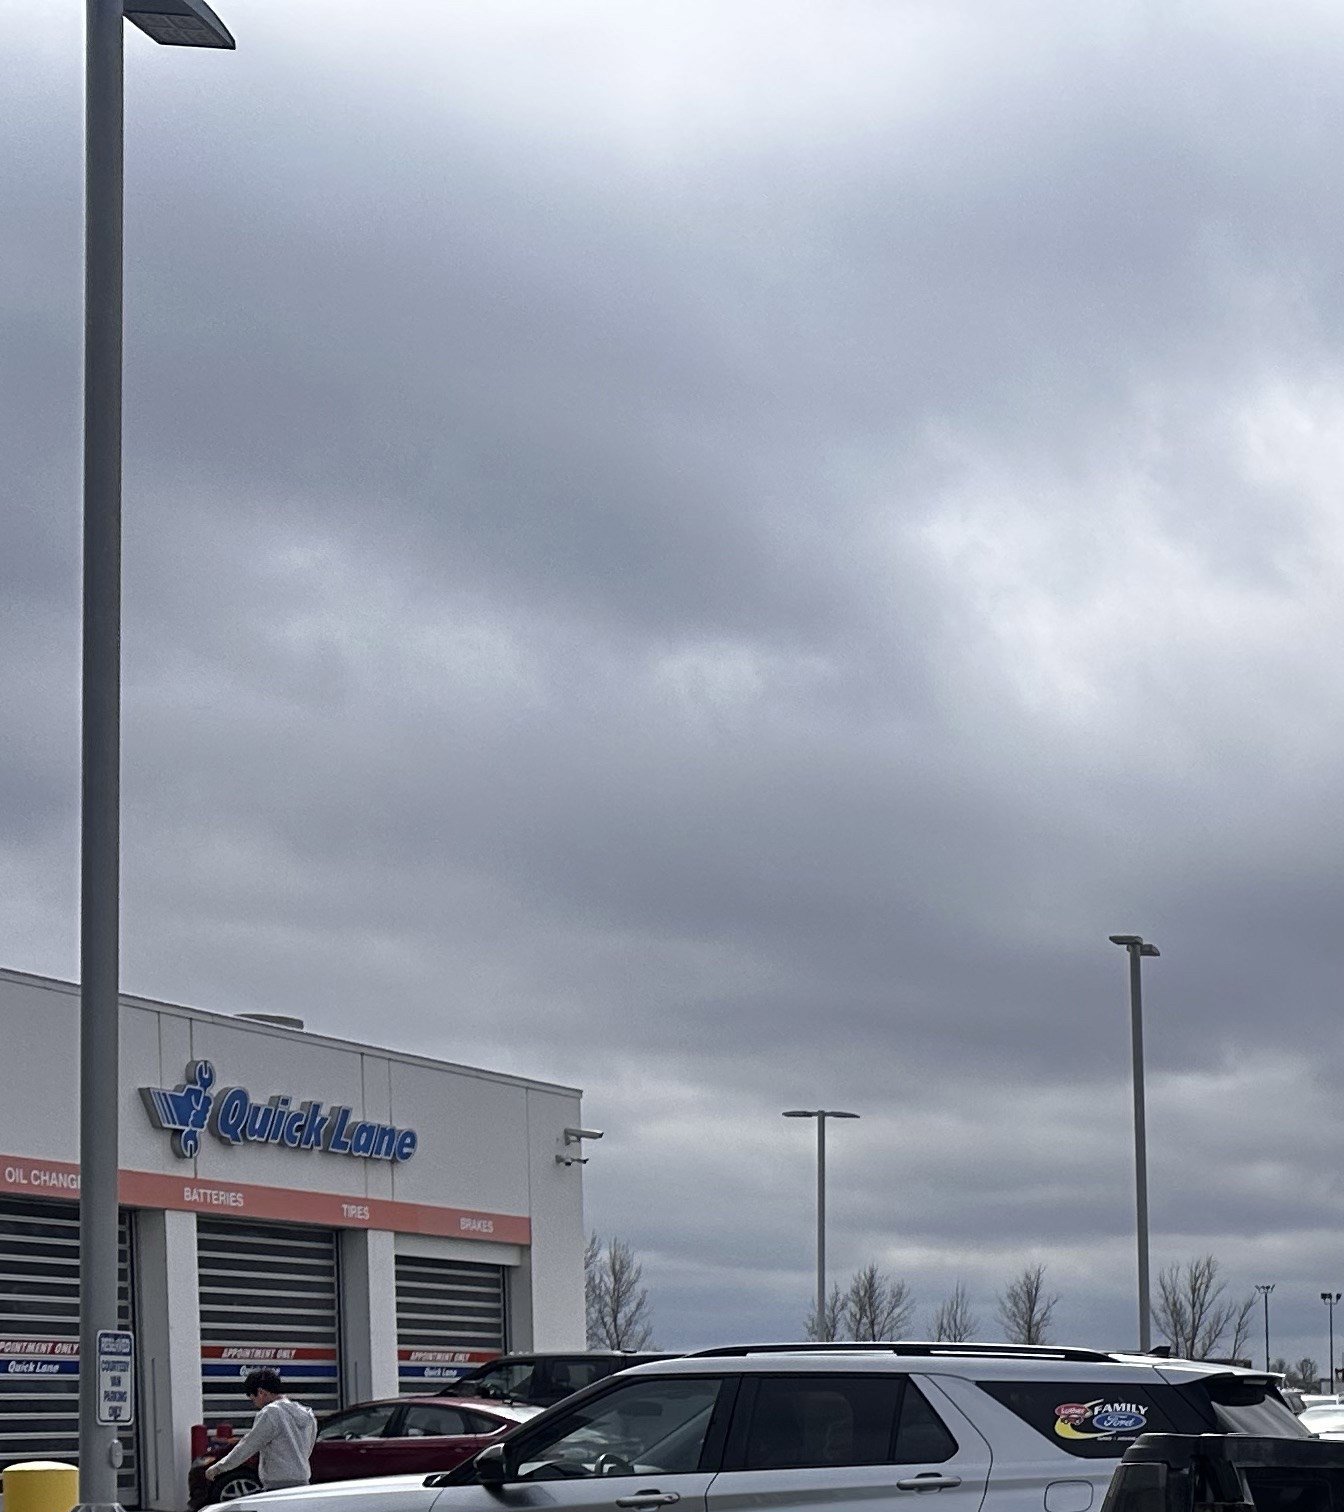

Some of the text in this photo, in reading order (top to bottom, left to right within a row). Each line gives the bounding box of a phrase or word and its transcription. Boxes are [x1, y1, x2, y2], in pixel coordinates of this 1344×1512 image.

[217, 1086, 418, 1163] Quick Lane
[5, 1167, 28, 1184] OIL
[184, 1186, 244, 1207] BATTERIES
[341, 1203, 370, 1220] TIRES
[460, 1217, 494, 1233] BRAKES
[54, 1342, 79, 1354] ONLY
[221, 1347, 297, 1360] APPOINTMENT ONLY
[8, 1360, 60, 1374] Quick Lane
[424, 1367, 457, 1377] Quick Lane
[1094, 1403, 1149, 1415] FAMILY
[1103, 1415, 1135, 1427] Ford
